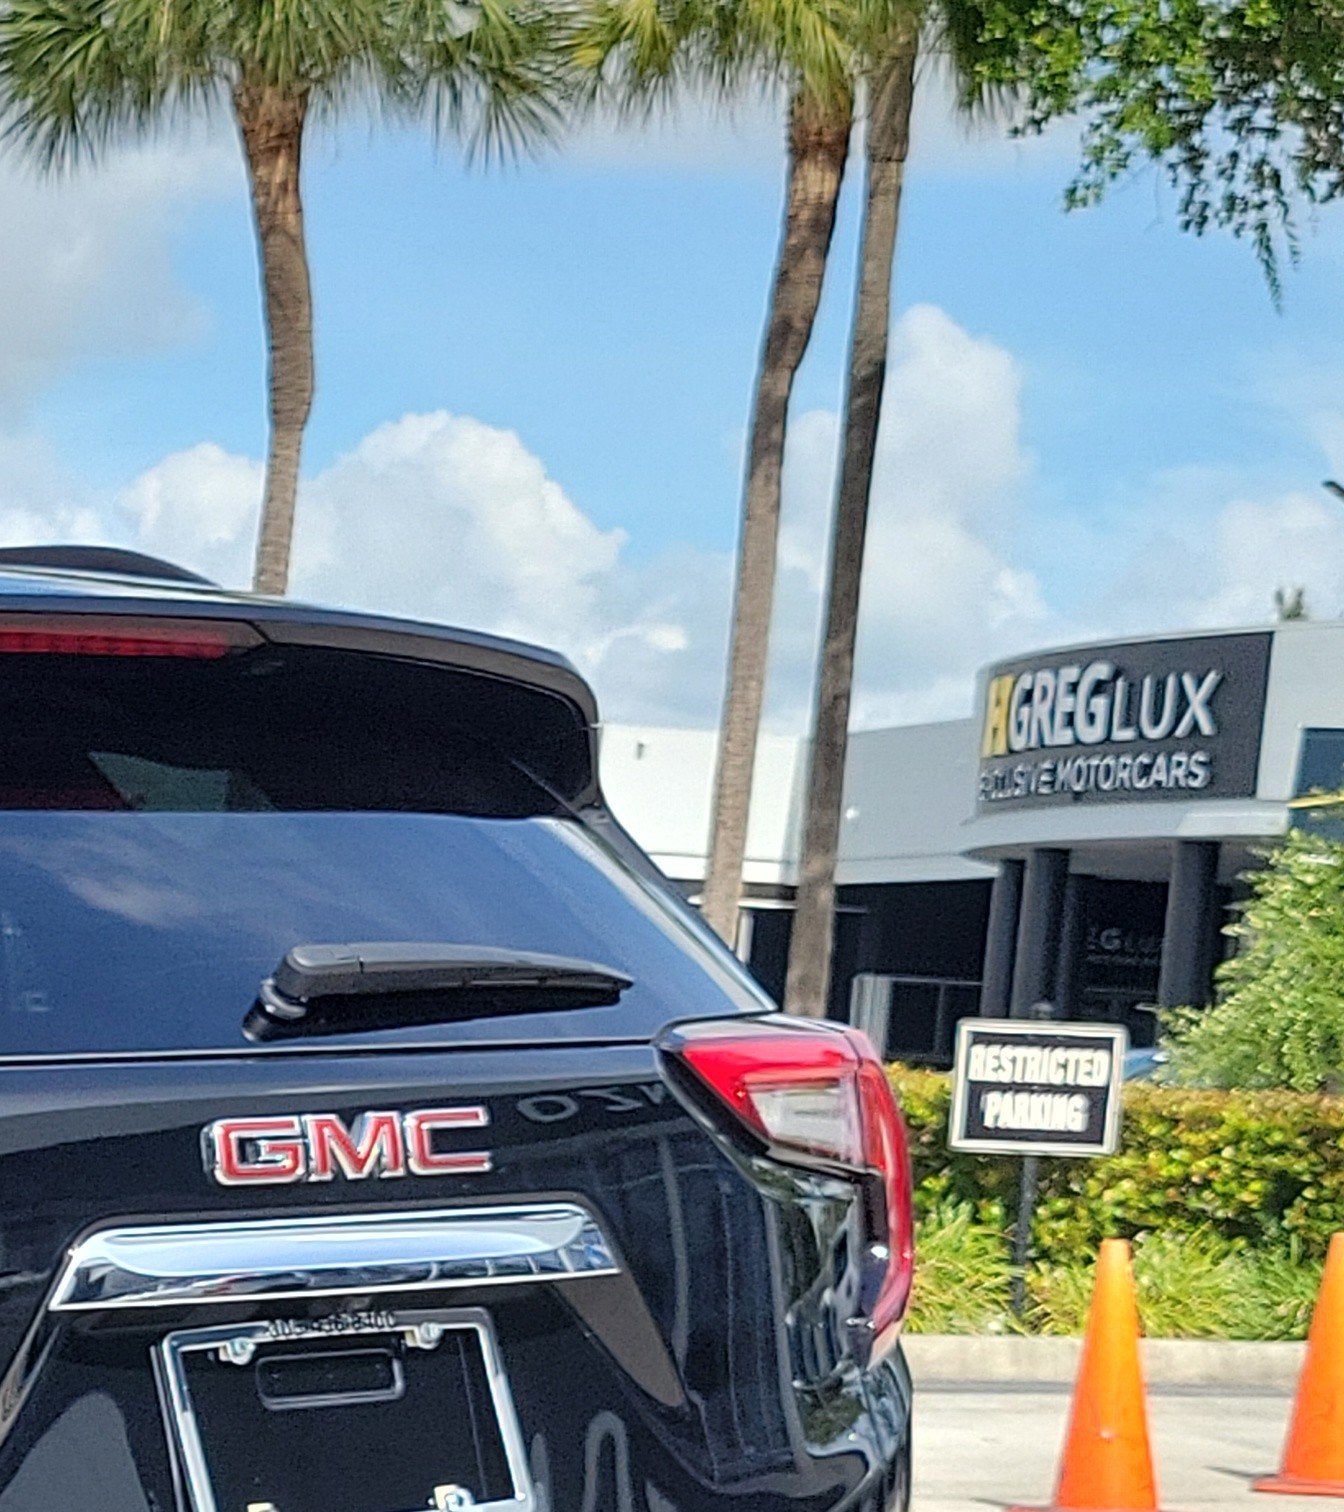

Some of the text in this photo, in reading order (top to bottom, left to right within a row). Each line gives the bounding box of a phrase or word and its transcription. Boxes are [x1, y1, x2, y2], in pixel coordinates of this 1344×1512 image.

[1055, 751, 1211, 793] MOTORCARS
[968, 1043, 1111, 1087] RESTRICTED
[980, 1090, 1090, 1132] PARKING
[204, 1106, 493, 1186] GMC
